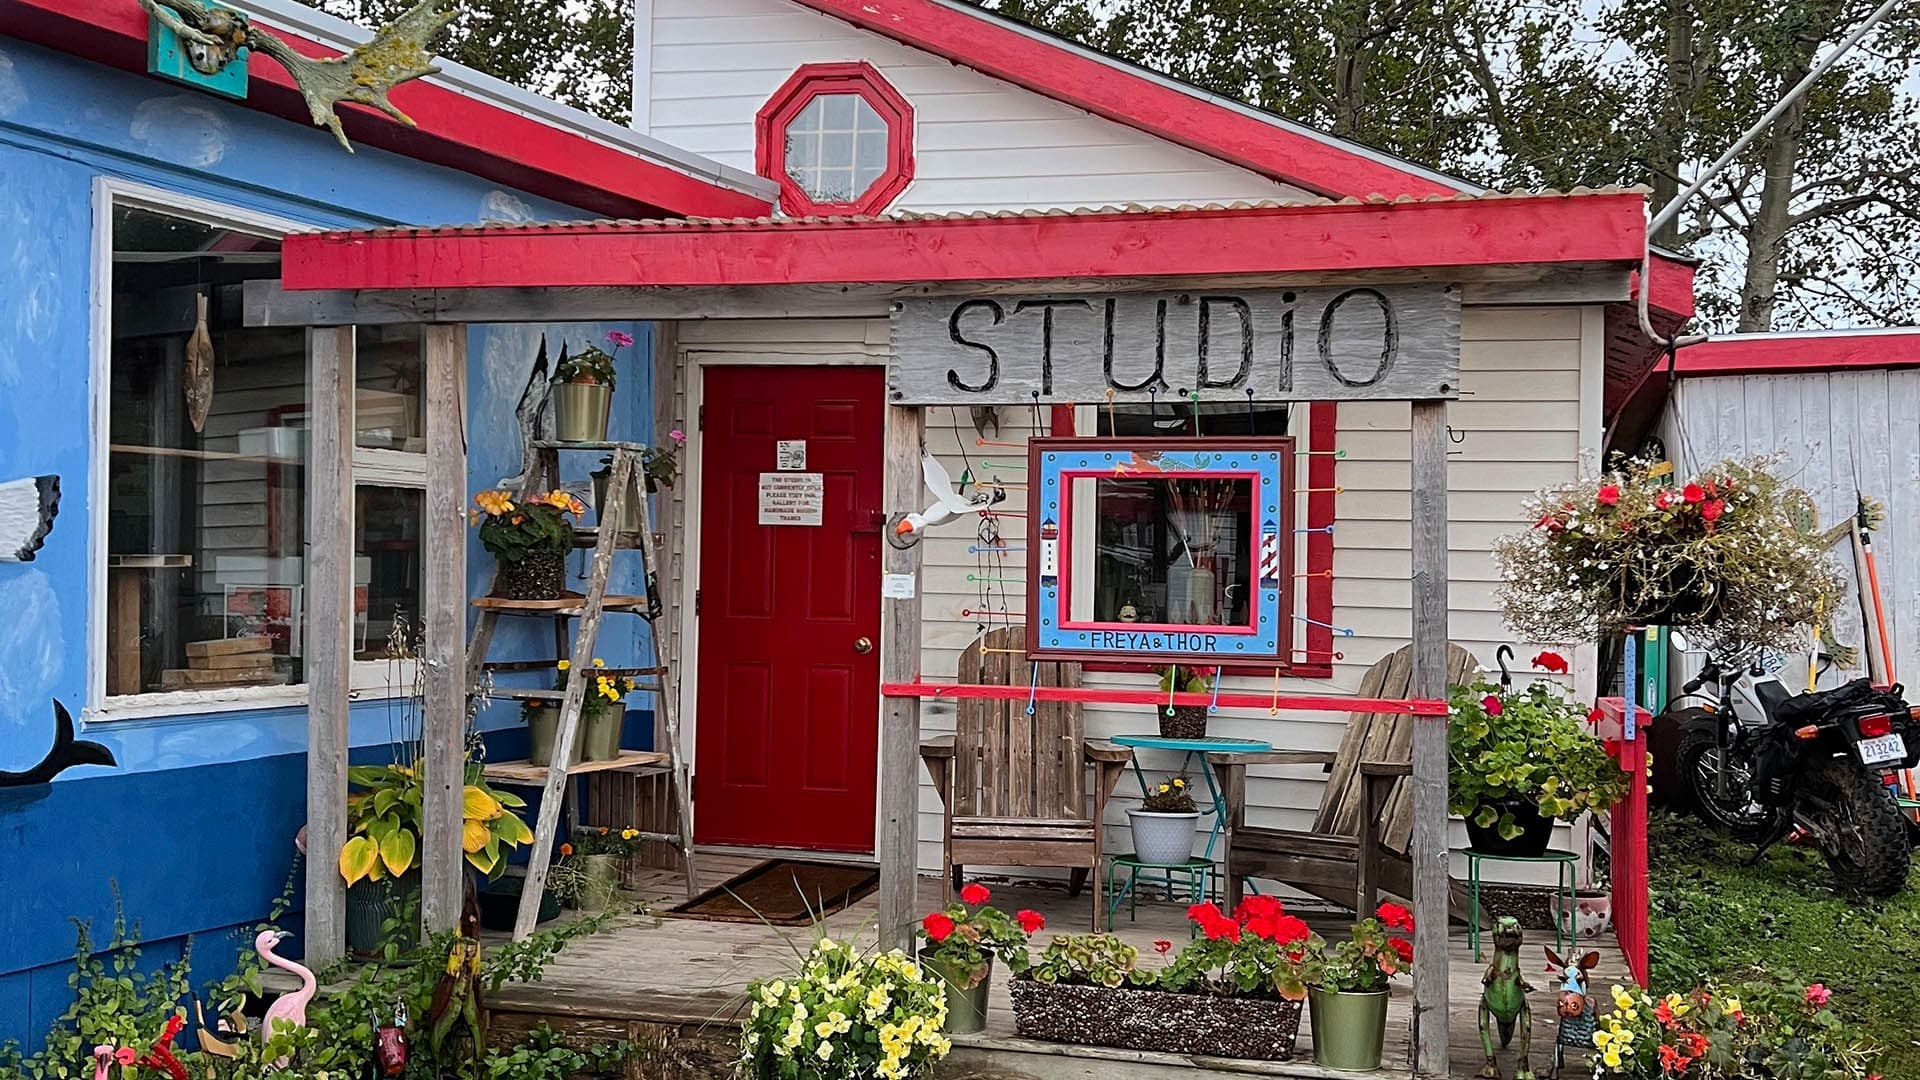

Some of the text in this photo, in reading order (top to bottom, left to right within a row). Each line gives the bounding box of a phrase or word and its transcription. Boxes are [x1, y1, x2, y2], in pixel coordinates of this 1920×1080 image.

[1091, 632, 1151, 649] FREYA
[1163, 633, 1216, 651] THOR
[1863, 740, 1901, 758] 213242
